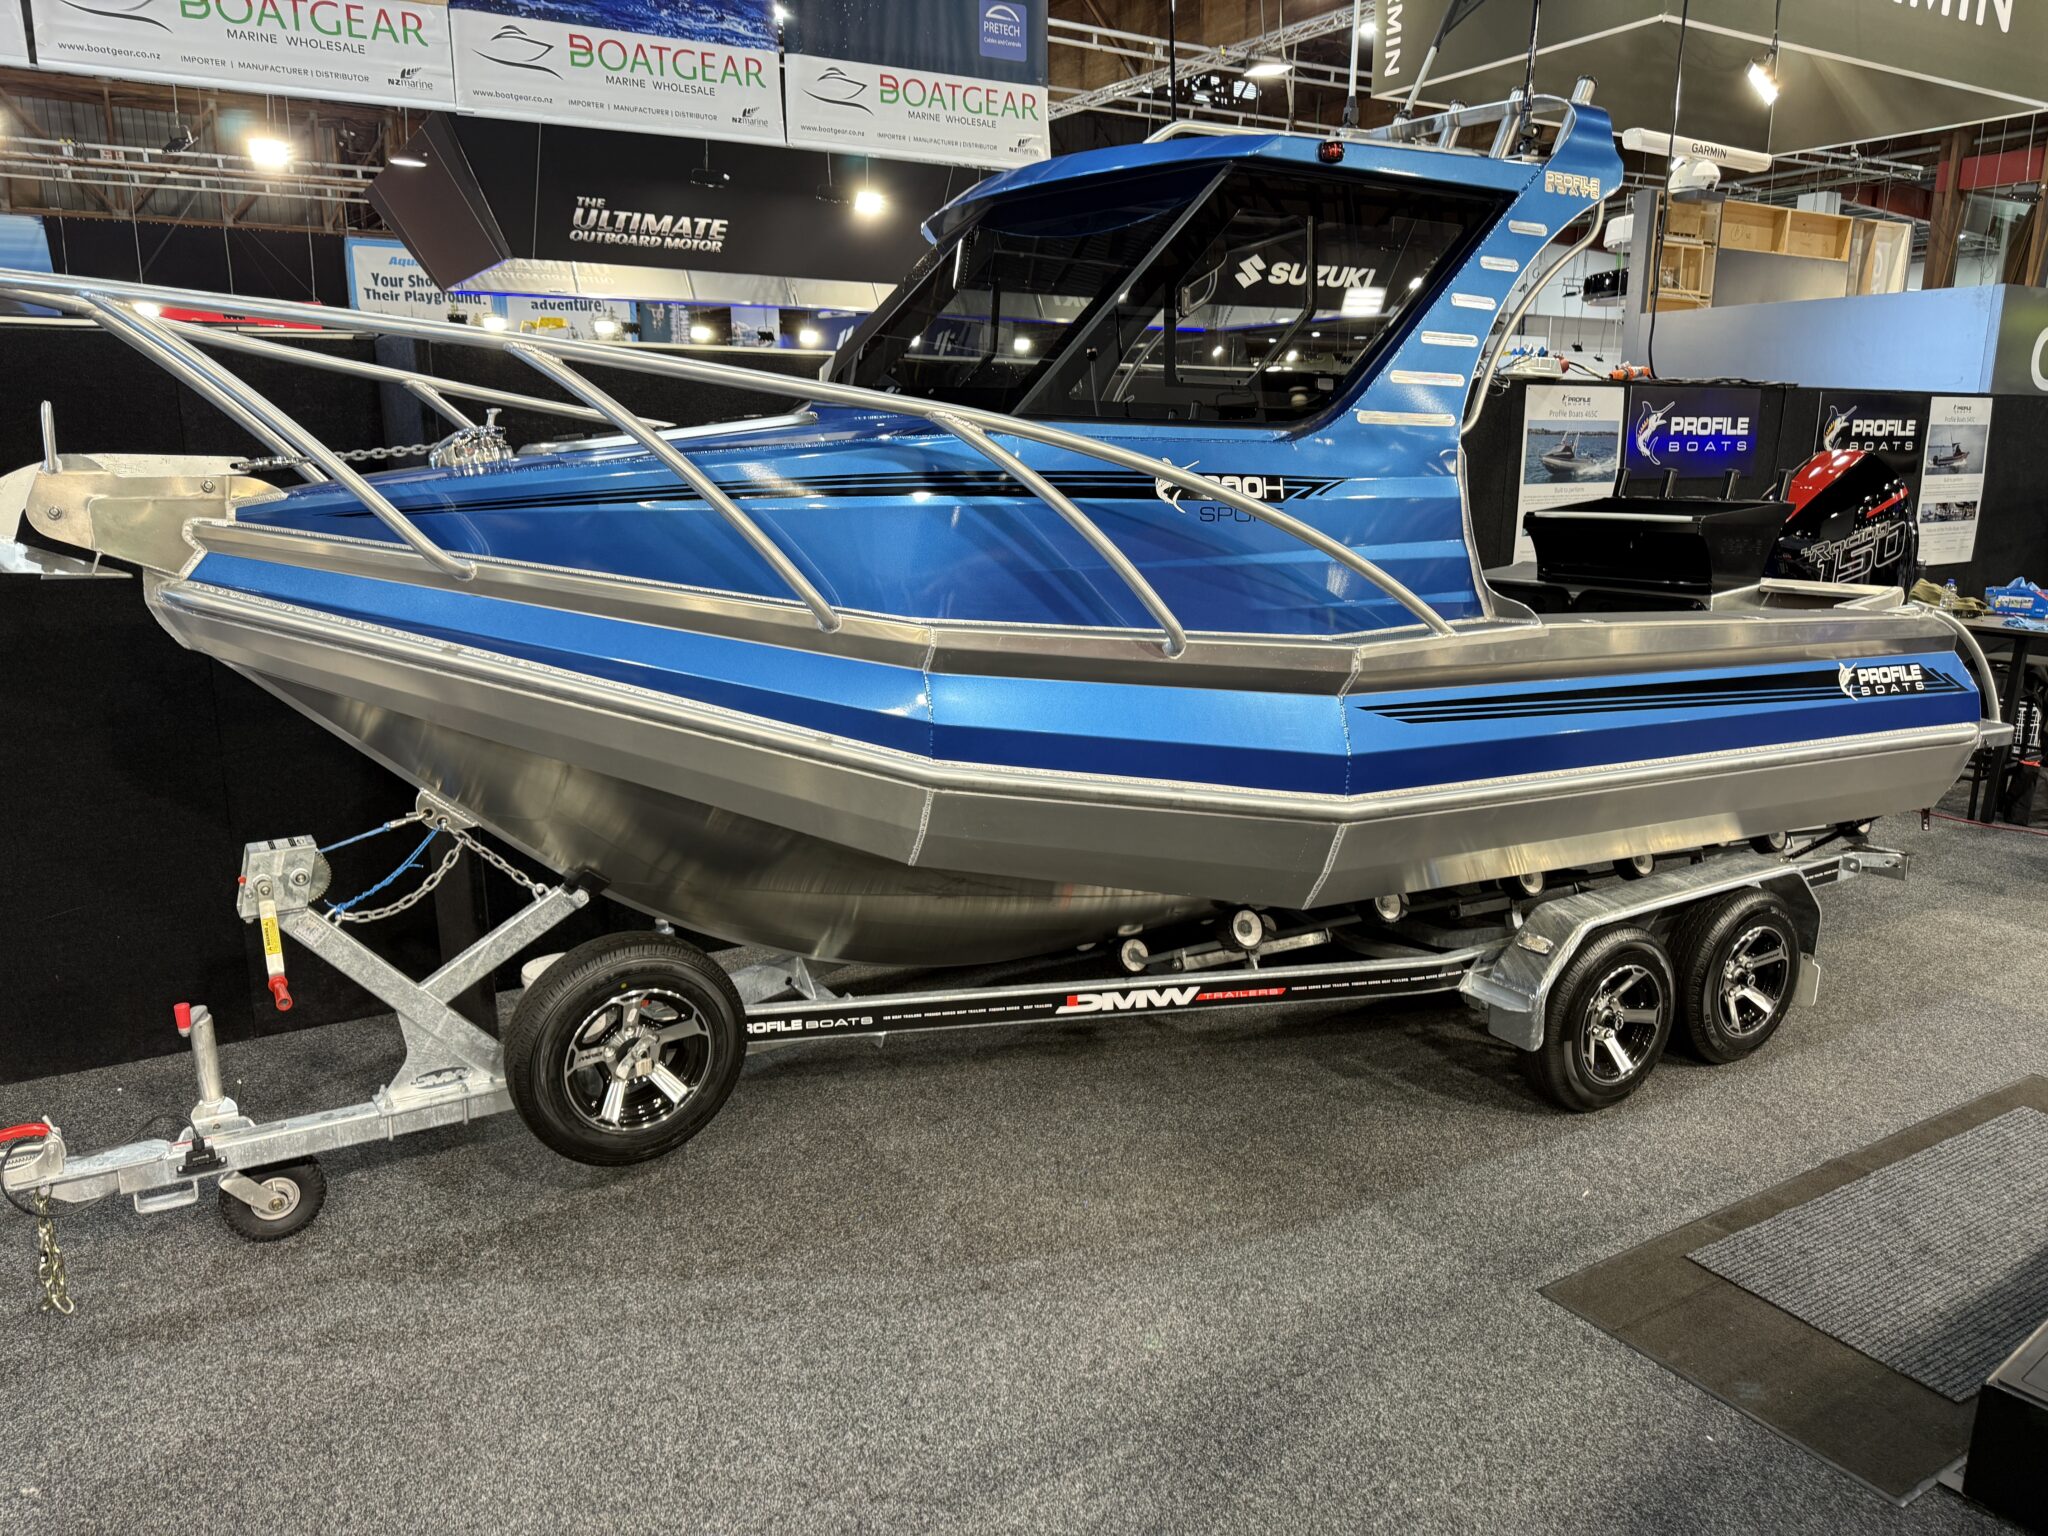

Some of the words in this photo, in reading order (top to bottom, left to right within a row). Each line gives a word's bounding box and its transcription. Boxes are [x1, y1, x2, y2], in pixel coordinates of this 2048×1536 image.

[983, 21, 1020, 37] PRETECH
[1384, 0, 1403, 77] MIN
[57, 41, 161, 60] www.boatgear.co.nz
[226, 29, 278, 44] MARINE
[285, 36, 366, 55] WHOLESALE
[180, 55, 226, 67] IMPORTER
[238, 61, 309, 77] MANUFACTURER
[315, 69, 370, 82] DISTRIBUTOR
[568, 33, 767, 88] BOATGEAR
[387, 77, 433, 91] NZmarine
[605, 75, 646, 89] MARINE
[652, 80, 716, 96] WHOLESALE
[472, 89, 553, 104] www.boatgear.co.nz
[879, 73, 1039, 121] BOATGEAR
[568, 99, 605, 110] IMPORTER
[613, 104, 669, 116] MANUFACTURER
[674, 111, 717, 121] DISTRIBUTOR
[907, 110, 940, 123] MARINE
[945, 115, 997, 129] WHOLESALE
[800, 124, 865, 137] www.boatgear.co.nz
[877, 132, 906, 141] IMPORTER
[913, 136, 959, 147] MANUFACTURER
[962, 141, 998, 151] DISTRIBUTOR
[1691, 143, 1727, 159] GARMIN
[1545, 170, 1600, 190] PROFILE
[1545, 184, 1600, 200] BOATS
[576, 196, 606, 209] THE
[572, 207, 729, 241] ULTIMATE
[569, 229, 662, 248] OUTBOARD
[663, 236, 723, 253] MOTOR
[389, 256, 418, 267] Aqu
[371, 272, 404, 288] Your
[408, 274, 437, 288] Sho
[1268, 262, 1376, 288] SUZUKI
[363, 287, 400, 302] Their
[404, 290, 487, 305] Playground.
[531, 299, 607, 313] adventure.
[1549, 409, 1567, 418] Profile
[1670, 416, 1750, 436] PROFILE
[1851, 419, 1917, 437] PROFILE
[1668, 440, 1747, 452] BOATS
[1849, 441, 1913, 451] BOATS
[1817, 521, 1906, 584] 150
[1857, 664, 1923, 685] PROFILE
[1860, 681, 1925, 696] BOATS
[1055, 986, 1200, 1014] DMW
[1205, 988, 1278, 999] TRAILERS
[746, 1019, 803, 1034] ROFILE
[805, 1016, 873, 1030] BOATS
